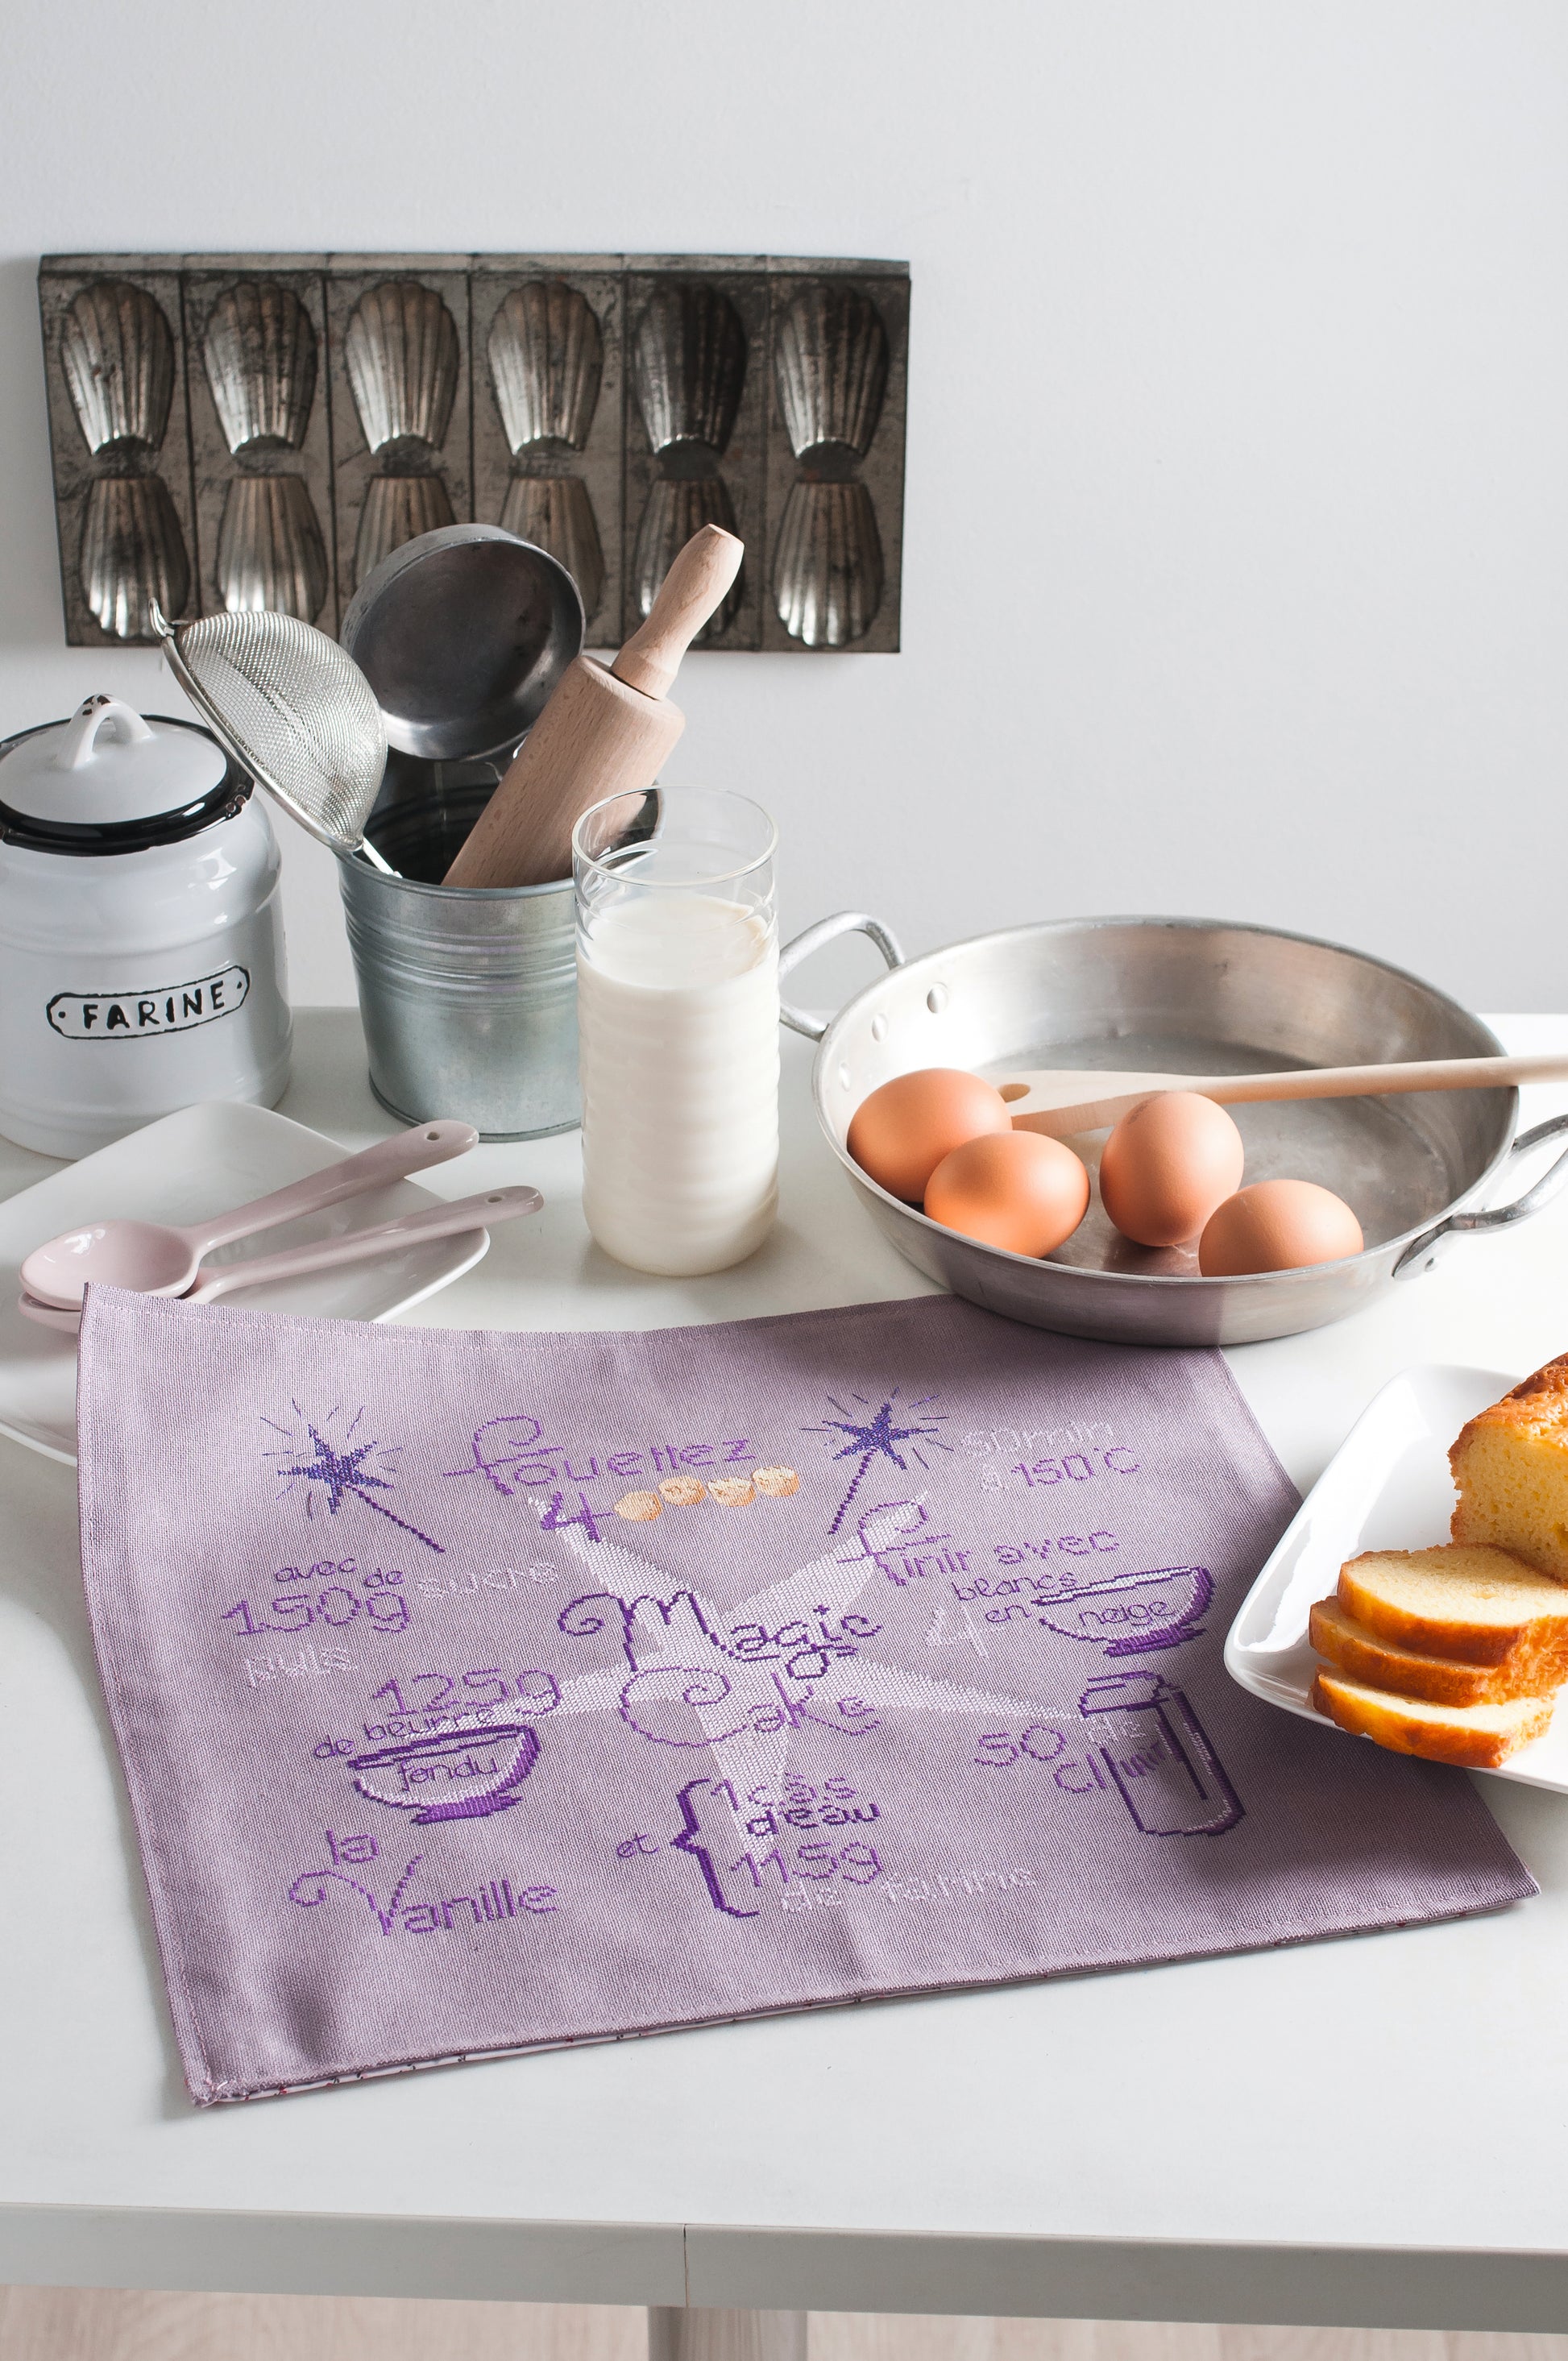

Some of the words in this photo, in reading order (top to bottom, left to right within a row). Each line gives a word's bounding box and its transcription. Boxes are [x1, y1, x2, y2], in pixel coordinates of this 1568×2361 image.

[83, 981, 225, 1030] FARINE
[541, 1492, 613, 1541] 4
[993, 1531, 1120, 1564] avec
[275, 1558, 357, 1583] avec
[363, 1567, 405, 1588] de
[952, 1573, 1077, 1601] blancs
[222, 1587, 411, 1636] 150g
[925, 1605, 1006, 1658] 4
[985, 1604, 1031, 1624] en
[1078, 1601, 1176, 1628] neige
[558, 1590, 883, 1680] Magic
[244, 1644, 359, 1688] puis
[373, 1668, 562, 1717] 125g
[620, 1666, 882, 1747] Cake
[313, 1735, 355, 1759] de
[364, 1708, 495, 1741] beurre
[1087, 1715, 1146, 1746] de
[398, 1754, 498, 1791] fondu
[326, 1829, 380, 1865] la
[616, 1831, 660, 1859] et
[732, 1840, 885, 1886] 115g
[288, 1854, 560, 1936] Vanille
[780, 1881, 842, 1913] de
